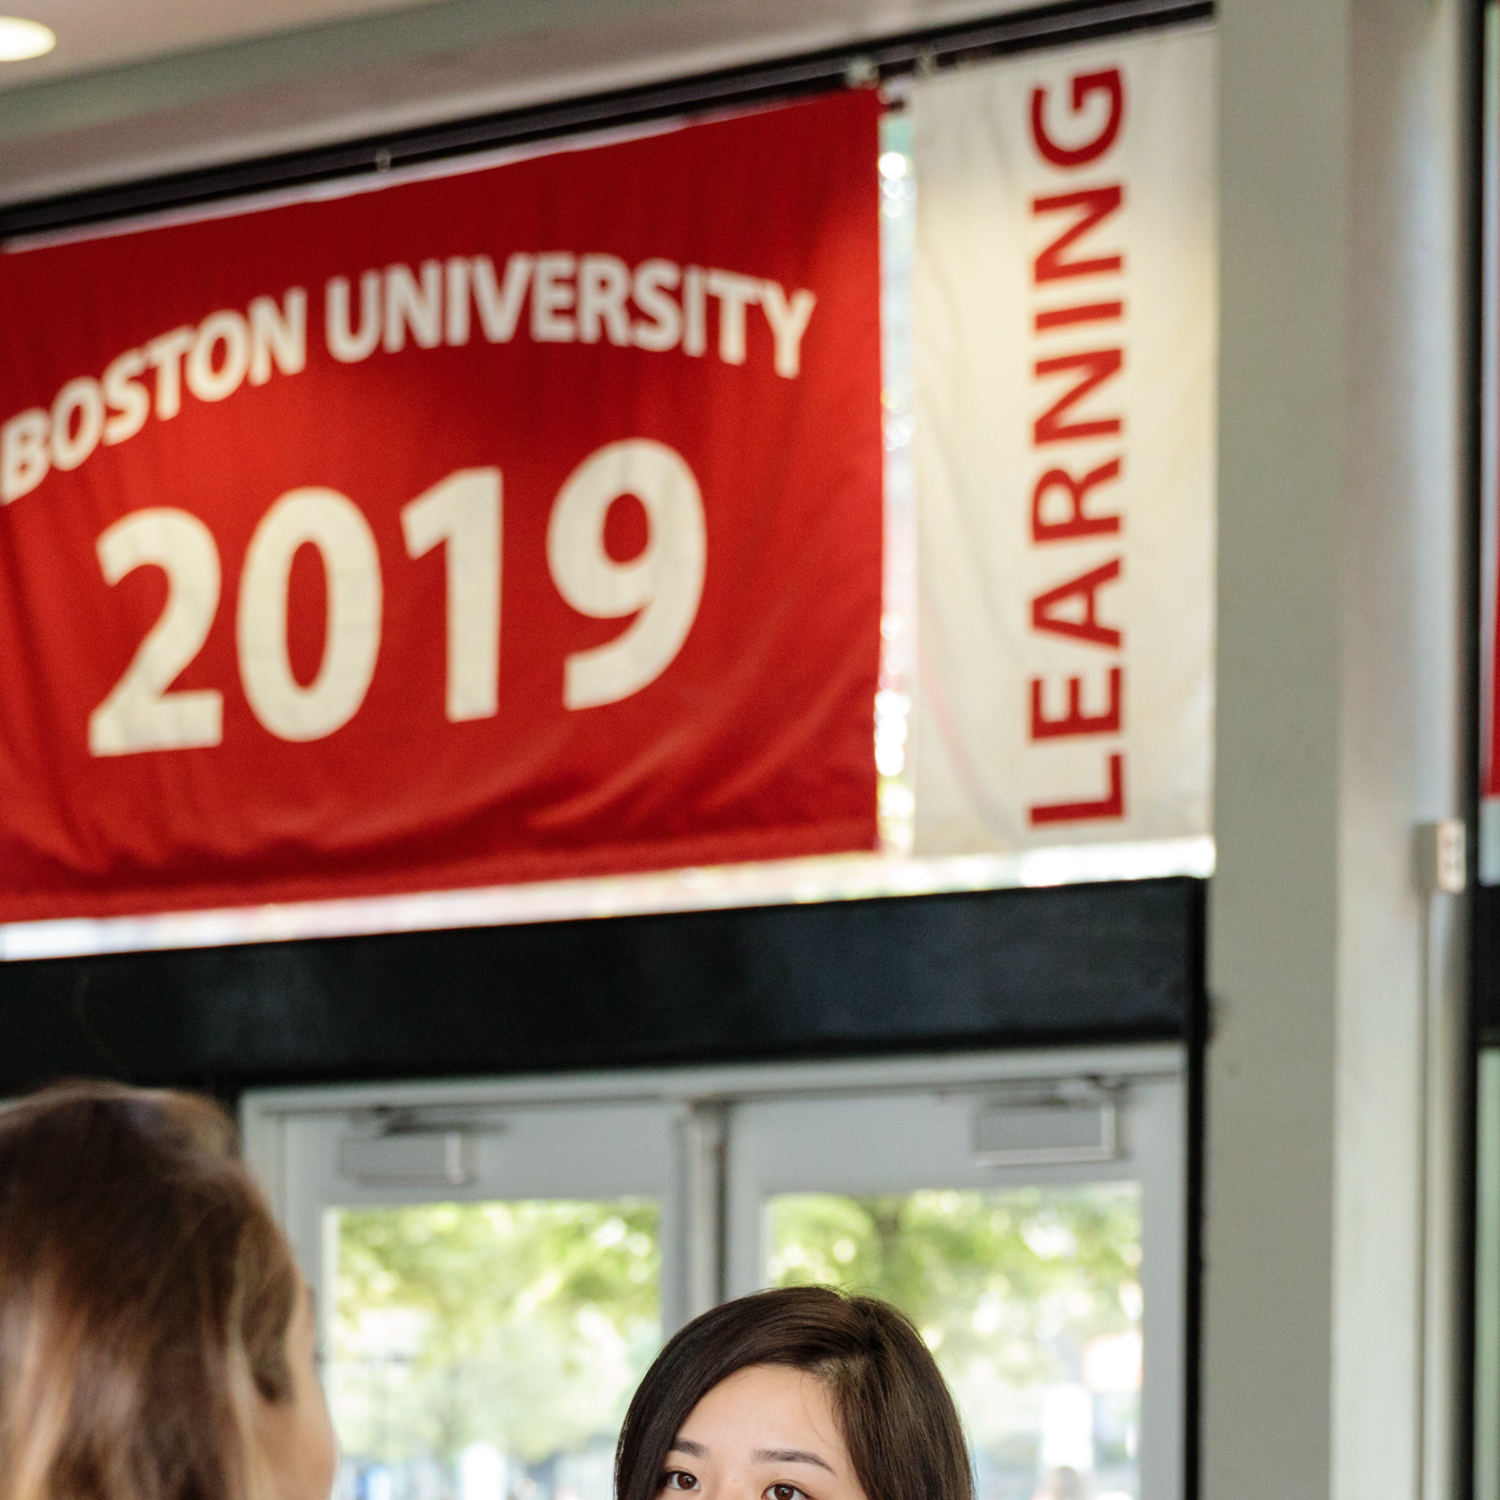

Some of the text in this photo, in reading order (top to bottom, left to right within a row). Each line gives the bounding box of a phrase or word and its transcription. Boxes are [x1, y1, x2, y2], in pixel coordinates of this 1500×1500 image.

[325, 251, 815, 380] UNIVERSITY
[1029, 63, 1128, 831] LEARNING
[87, 437, 706, 758] 2019
